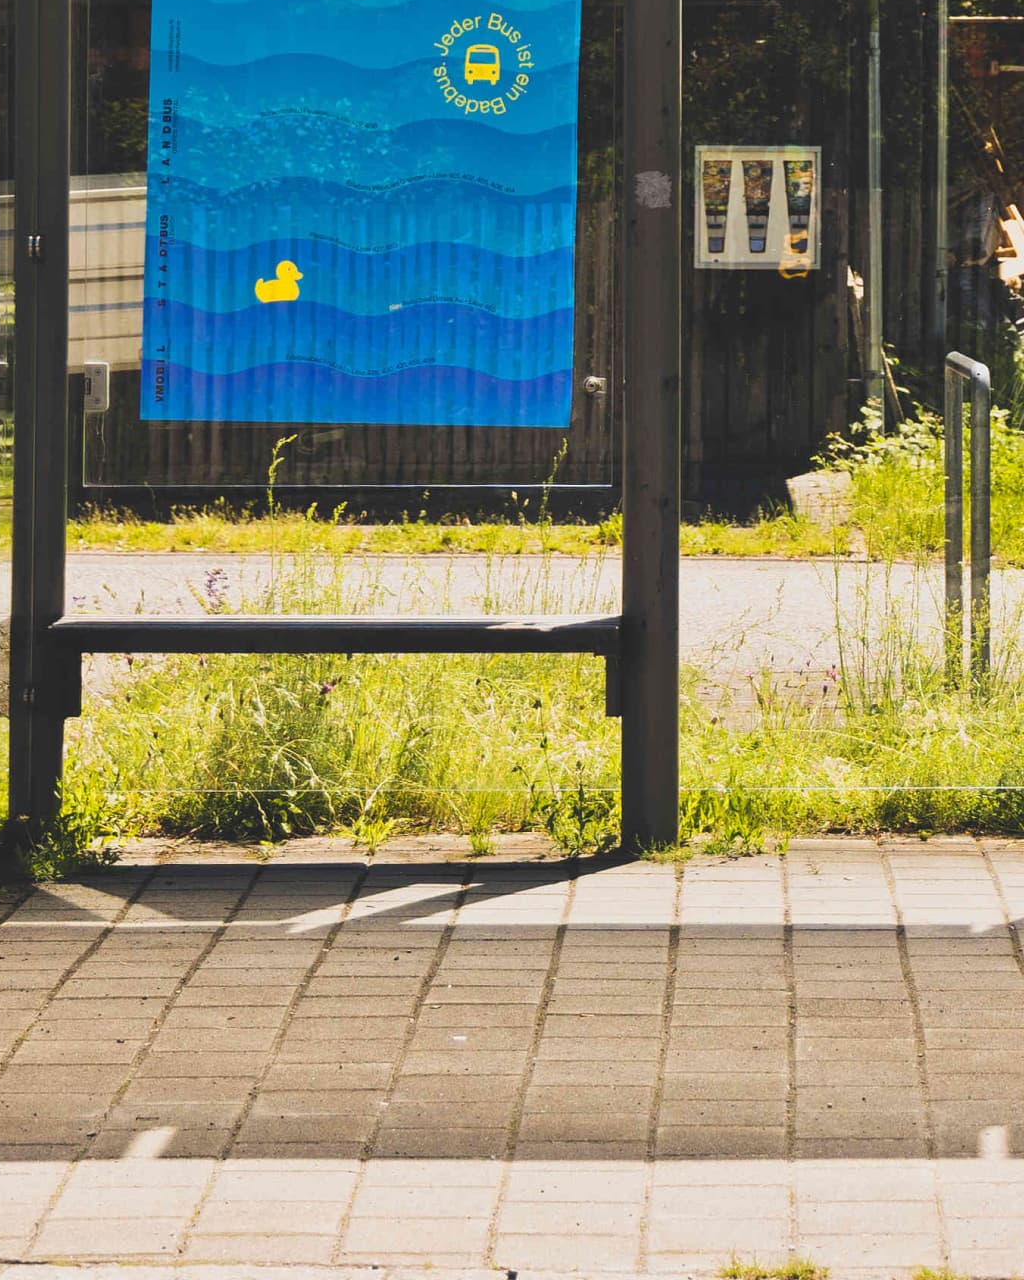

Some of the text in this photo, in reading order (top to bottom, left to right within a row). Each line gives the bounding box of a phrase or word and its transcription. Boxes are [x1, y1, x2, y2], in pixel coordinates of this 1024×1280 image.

[433, 13, 535, 115] Jeder Bus ist ein Badebus.
